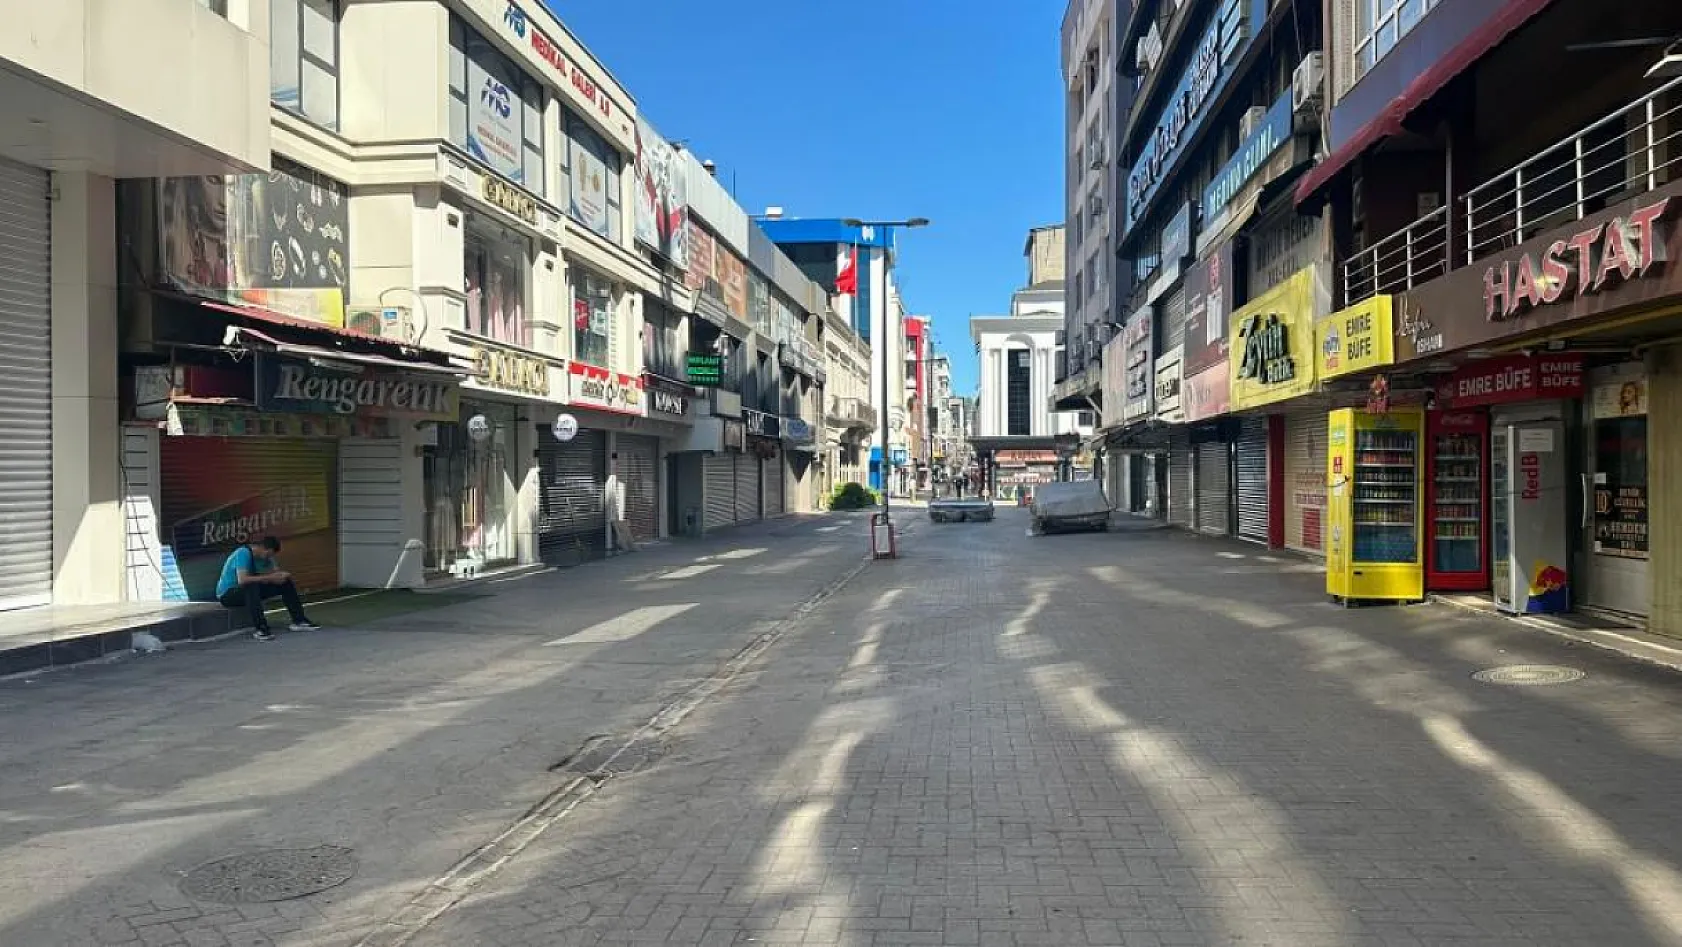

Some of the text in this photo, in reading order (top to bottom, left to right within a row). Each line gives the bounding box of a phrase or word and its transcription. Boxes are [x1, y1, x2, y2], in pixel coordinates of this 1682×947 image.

[1483, 197, 1671, 322] HASTAT
[1346, 311, 1371, 338] EMRE
[1459, 365, 1532, 398] EMRE BÜFE
[1540, 361, 1584, 374] EMRE
[273, 363, 452, 415] Rengarenk
